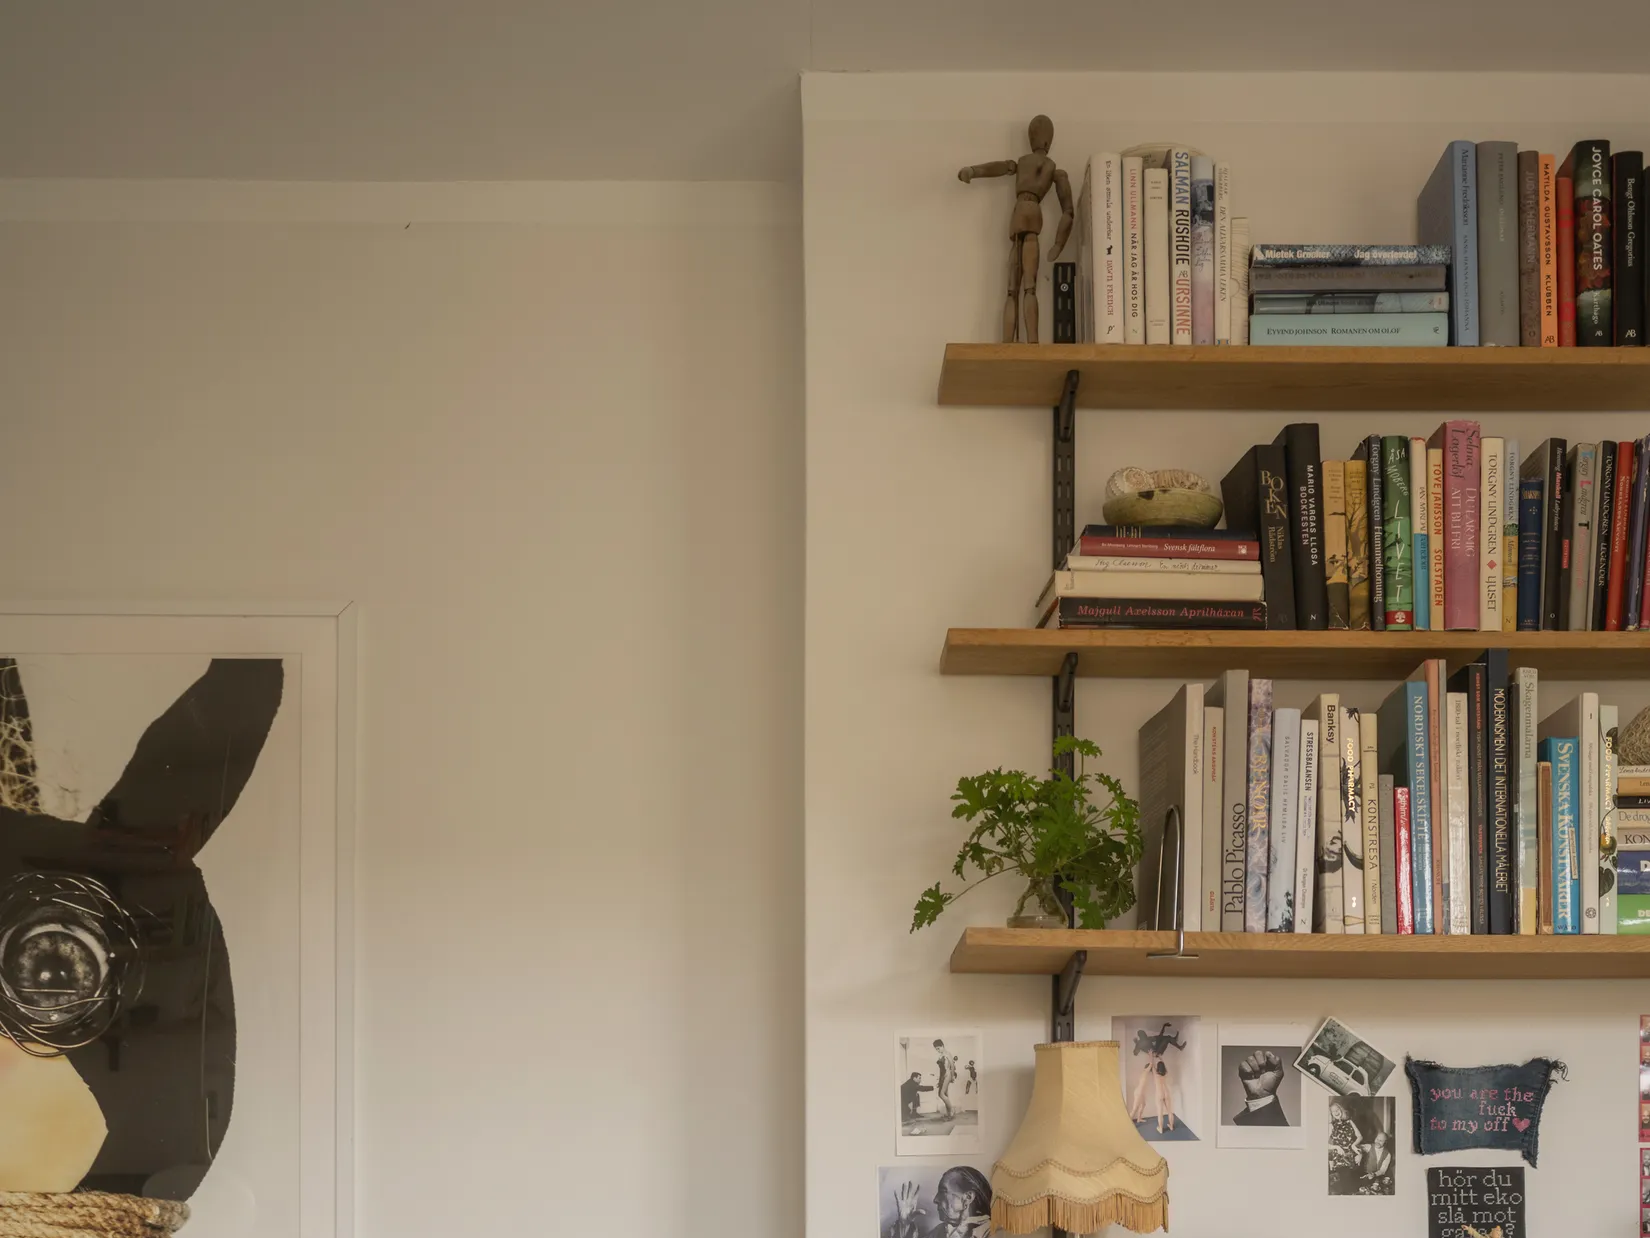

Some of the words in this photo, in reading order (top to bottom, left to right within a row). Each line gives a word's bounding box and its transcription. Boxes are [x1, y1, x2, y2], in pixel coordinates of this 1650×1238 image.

[1130, 168, 1138, 188] LINN
[1176, 151, 1189, 205] SALMAN
[1461, 148, 1471, 185] Marianne
[1592, 146, 1603, 186] JOYCE
[1461, 185, 1471, 227] Fredriksson
[1525, 171, 1536, 207] JUDITH
[1626, 177, 1637, 200] Bengt
[1592, 188, 1603, 230] CAROL
[1628, 200, 1637, 231] Ohlsson
[1131, 232, 1140, 250] NÄR
[1176, 209, 1190, 266] RUSHDIE
[1526, 211, 1537, 265] HERMANN
[1593, 232, 1604, 272] OATES
[1626, 231, 1637, 268] Gregorius
[1131, 270, 1140, 282] ÄR
[1177, 278, 1190, 336] URSINNE
[1266, 327, 1293, 336] EYVIND
[1294, 327, 1328, 337] JOHNSON
[1371, 443, 1382, 475] Torgny
[1387, 447, 1406, 465] ÅSA
[1449, 427, 1466, 482] Lagerlöf
[1465, 427, 1479, 468] Selma
[1306, 464, 1315, 494] MARIO
[1386, 463, 1409, 497] MOBERG
[1433, 463, 1442, 489] TOVE
[1488, 454, 1498, 498] TORGNY
[1555, 471, 1563, 500] Mankell
[1604, 455, 1613, 490] TORGNY
[1299, 485, 1310, 546] BOCKFESTEN
[1308, 497, 1317, 534] VARGAS
[1372, 477, 1383, 521] Lindgren
[1432, 492, 1443, 536] JANSSON
[1601, 491, 1611, 536] LINDGREN
[1276, 525, 1286, 550] Niklas
[1487, 500, 1498, 556] LINDGREN
[1163, 542, 1187, 553] Svensk
[1187, 543, 1217, 556] fältflora
[1310, 536, 1319, 567] LLOSA
[1373, 525, 1385, 604] Hummelhonung
[1507, 538, 1515, 563] Minnen
[1434, 548, 1443, 607] SOLSTADEN
[1485, 574, 1497, 613] LJUSET
[1076, 605, 1121, 619] Majgull
[1125, 605, 1176, 619] Axelsson
[1178, 606, 1244, 622] Aprilhäxan
[1325, 704, 1337, 744] Banksy
[1413, 695, 1425, 759] NORDISKT
[1492, 687, 1506, 752] MODERNISMEN
[1522, 682, 1535, 760] Skagenmålarna
[1304, 731, 1315, 792] STRESSBALANSEN
[1345, 736, 1356, 763] FOOD
[1494, 757, 1506, 774] DET
[1604, 736, 1613, 762] FOOD
[1252, 753, 1268, 831] RENOIR
[1346, 764, 1357, 813] PHARMACY
[1556, 741, 1574, 812] SVENSKA
[1415, 761, 1427, 840] SEKELSKIFTE
[1494, 775, 1508, 852] INTERNATIONELLA
[1224, 802, 1246, 864] Picasso
[1367, 798, 1378, 871] KONSTRESA
[1224, 867, 1244, 915] Pablo
[1495, 853, 1509, 894] MÅLERIET
[1371, 882, 1379, 905] Norden
[1430, 1087, 1463, 1102] you
[1469, 1088, 1498, 1101] are
[1503, 1086, 1534, 1103] the
[1478, 1101, 1517, 1117] fuck
[1430, 1116, 1447, 1131] to
[1451, 1119, 1479, 1134] my
[1483, 1116, 1511, 1132] off
[1431, 1187, 1479, 1206] mitt
[1483, 1187, 1523, 1205] eko
[1438, 1169, 1477, 1188] hör
[1482, 1169, 1513, 1188] du
[1437, 1207, 1467, 1224] slå
[1472, 1206, 1517, 1224] mot
